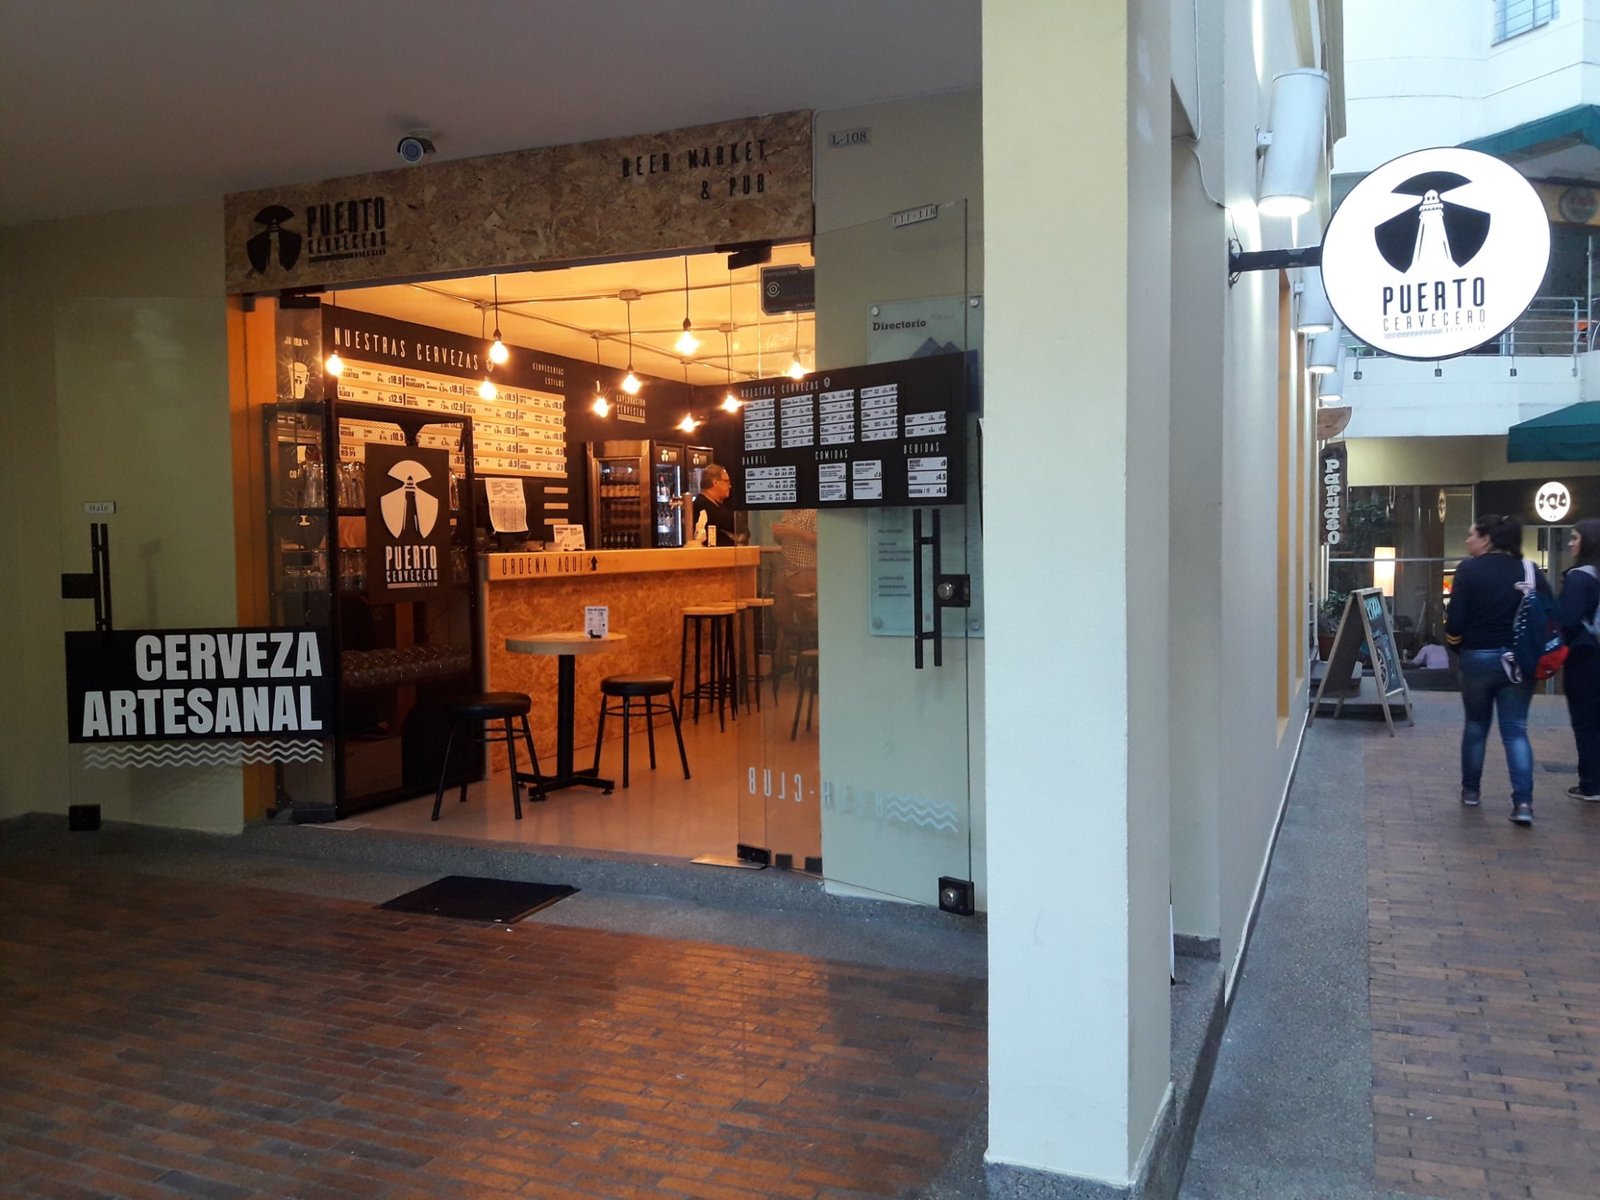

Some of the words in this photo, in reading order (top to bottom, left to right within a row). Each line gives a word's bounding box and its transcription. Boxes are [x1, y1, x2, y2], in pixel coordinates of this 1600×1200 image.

[622, 153, 670, 178] BEER
[687, 138, 768, 169] MARKET
[701, 180, 710, 200] &
[729, 173, 765, 197] PUB
[306, 197, 385, 238] PUERTO
[307, 231, 386, 255] CERVECERO
[1382, 277, 1485, 316] PUERTO
[872, 319, 927, 332] Directorio
[1383, 309, 1486, 332] CERVECERO
[334, 327, 406, 358] NUESTRAS
[416, 343, 479, 372] CERVEZAS
[781, 380, 819, 394] CERVEZAS
[903, 442, 940, 455] BEBIDAS
[385, 545, 437, 570] PUERTO
[502, 556, 548, 576] ORDENA
[385, 569, 438, 583] CERVECERO
[135, 631, 323, 682] CERVEZA
[82, 685, 323, 737] ARTESANAL
